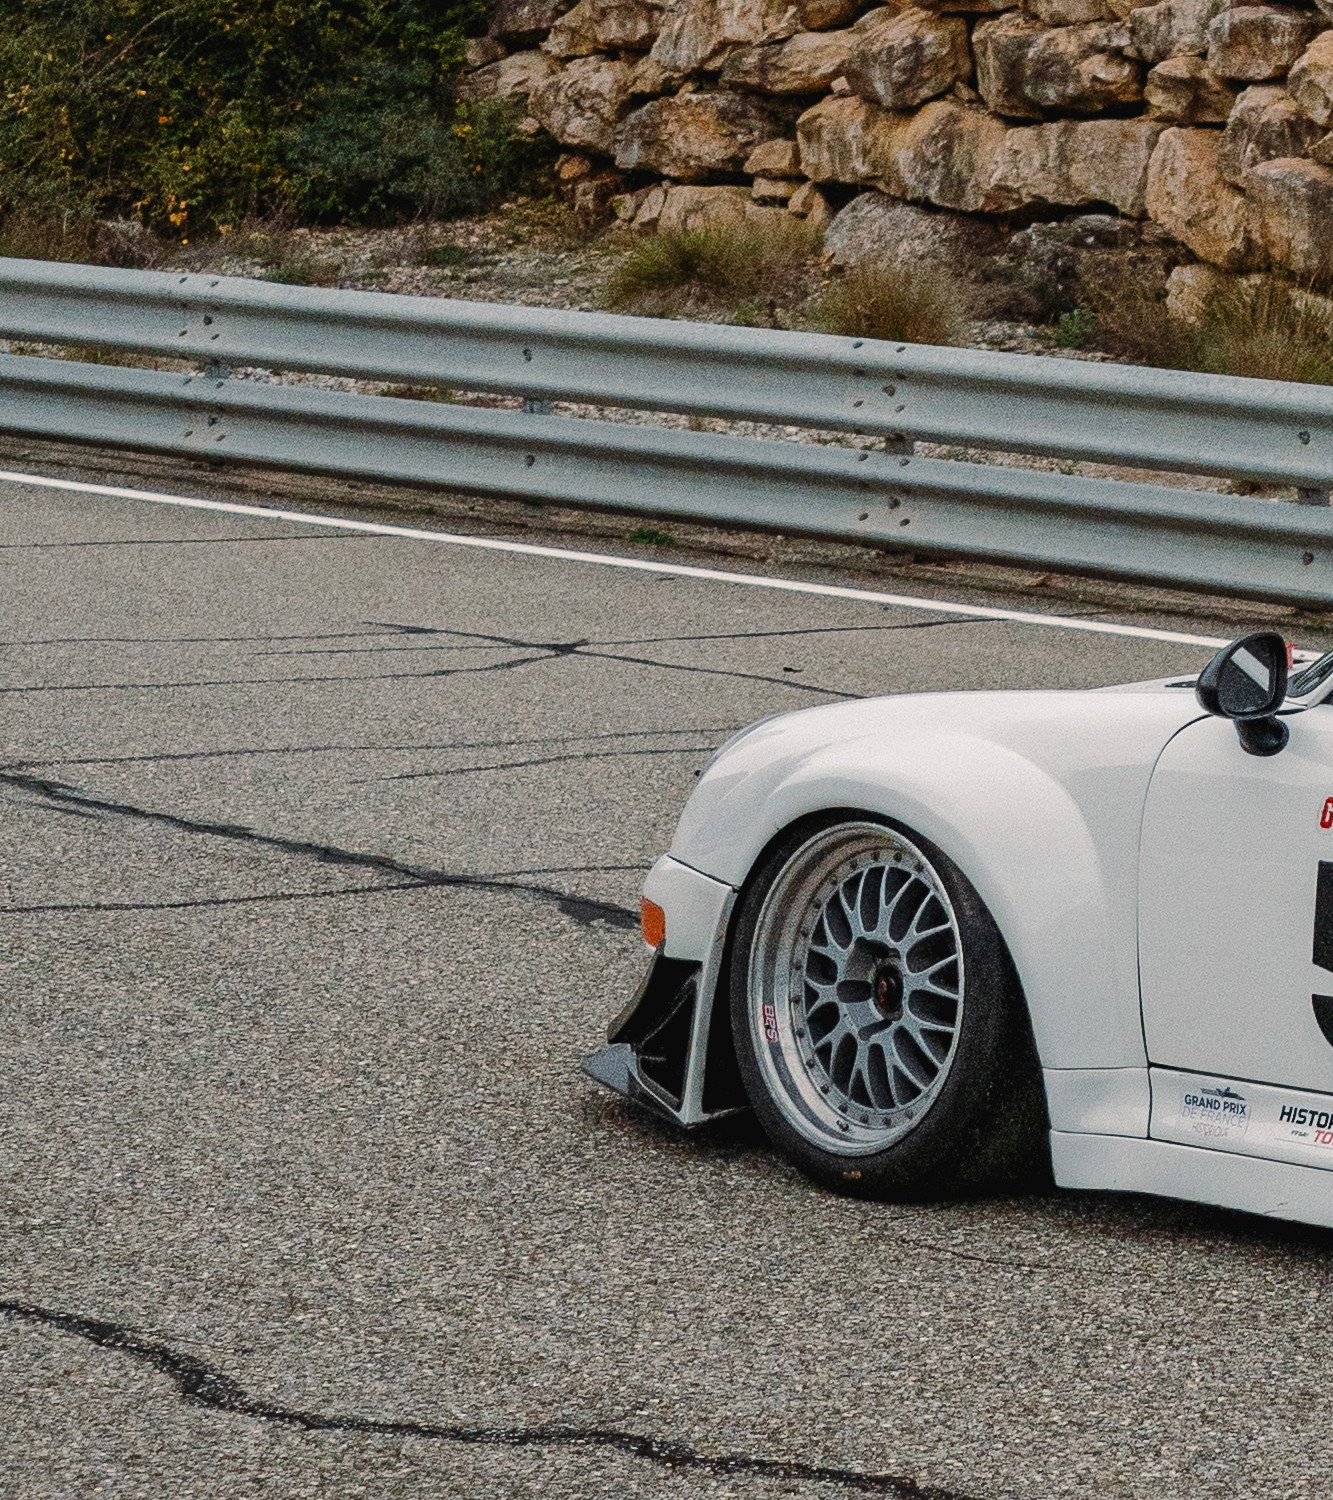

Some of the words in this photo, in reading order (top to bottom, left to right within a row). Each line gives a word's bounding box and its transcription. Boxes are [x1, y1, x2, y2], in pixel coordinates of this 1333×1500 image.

[1184, 1094, 1221, 1111] GRAND
[1222, 1101, 1247, 1116] PRIX
[1182, 1105, 1199, 1119] DE
[1200, 1109, 1247, 1128] FRANCE
